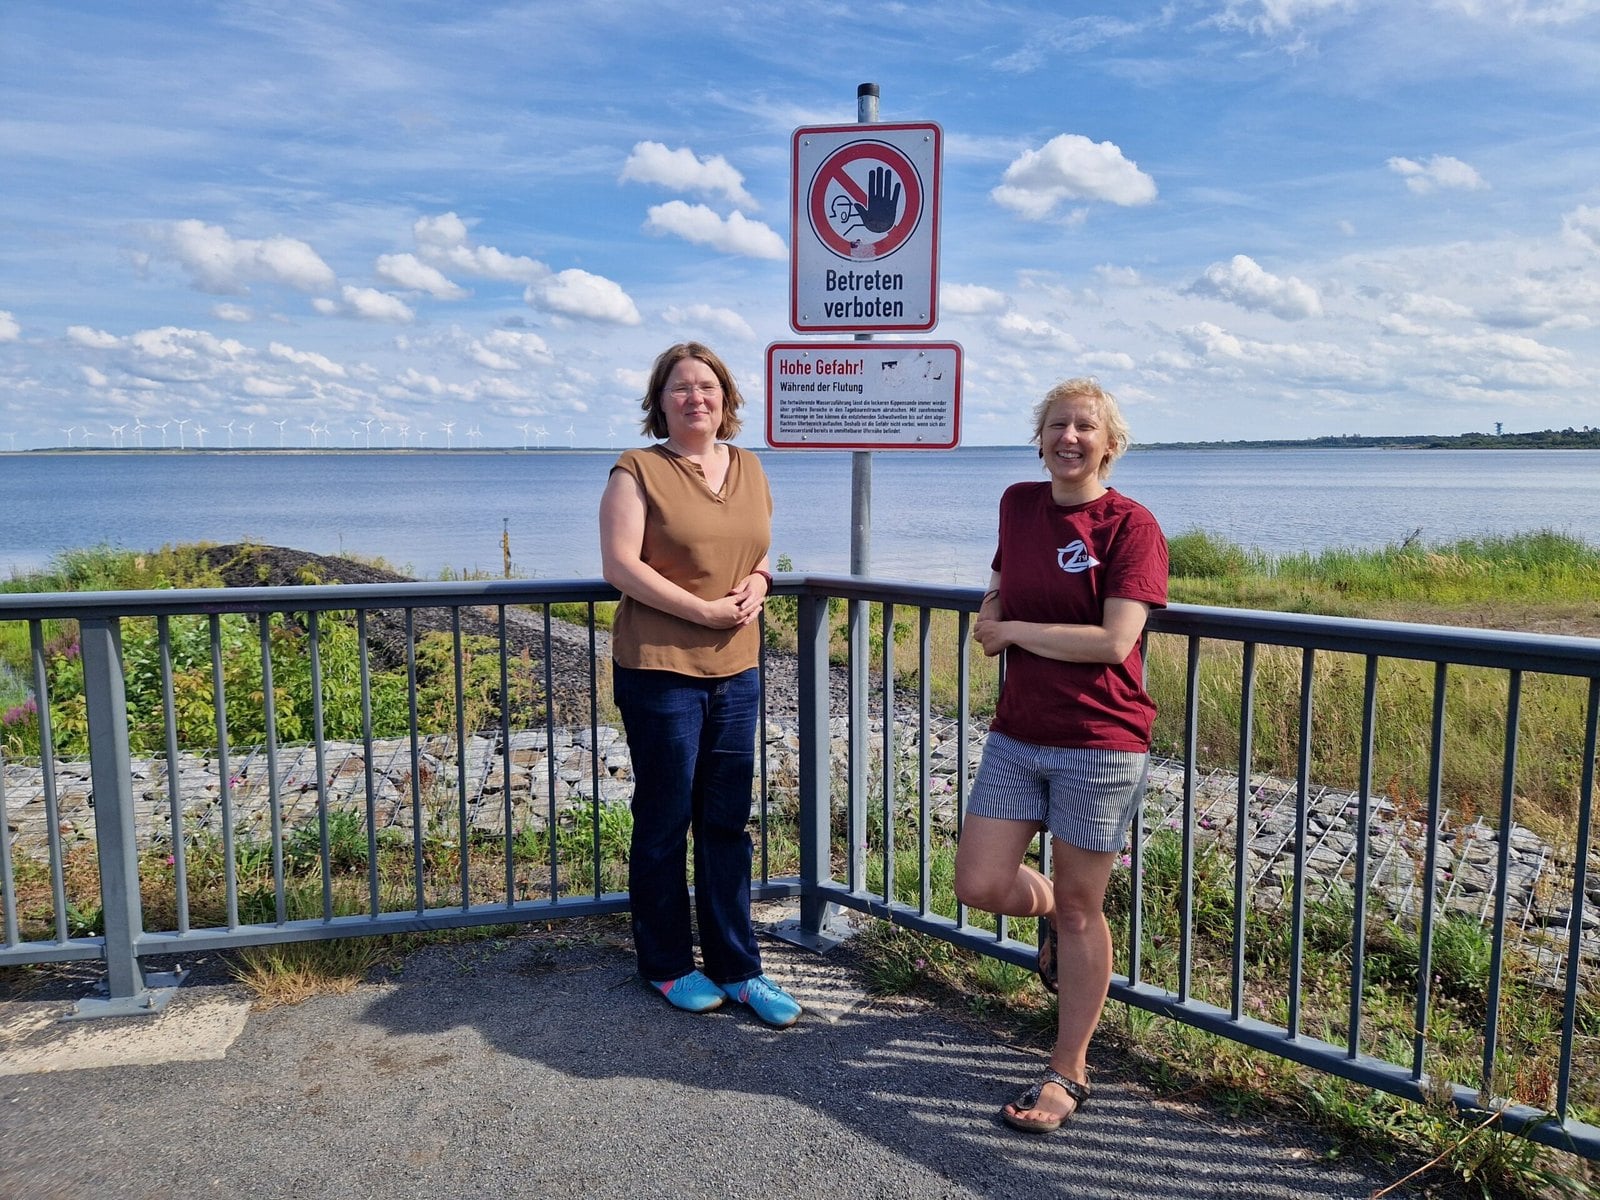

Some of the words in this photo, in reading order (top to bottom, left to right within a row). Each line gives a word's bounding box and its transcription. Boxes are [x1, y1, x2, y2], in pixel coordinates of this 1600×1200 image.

[826, 269, 903, 291] Betreten
[824, 296, 904, 318] verboten
[780, 359, 812, 375] Hohe
[816, 359, 864, 375] Gefahr!
[780, 382, 816, 392] Während
[817, 382, 831, 392] der
[833, 382, 863, 394] Flutung
